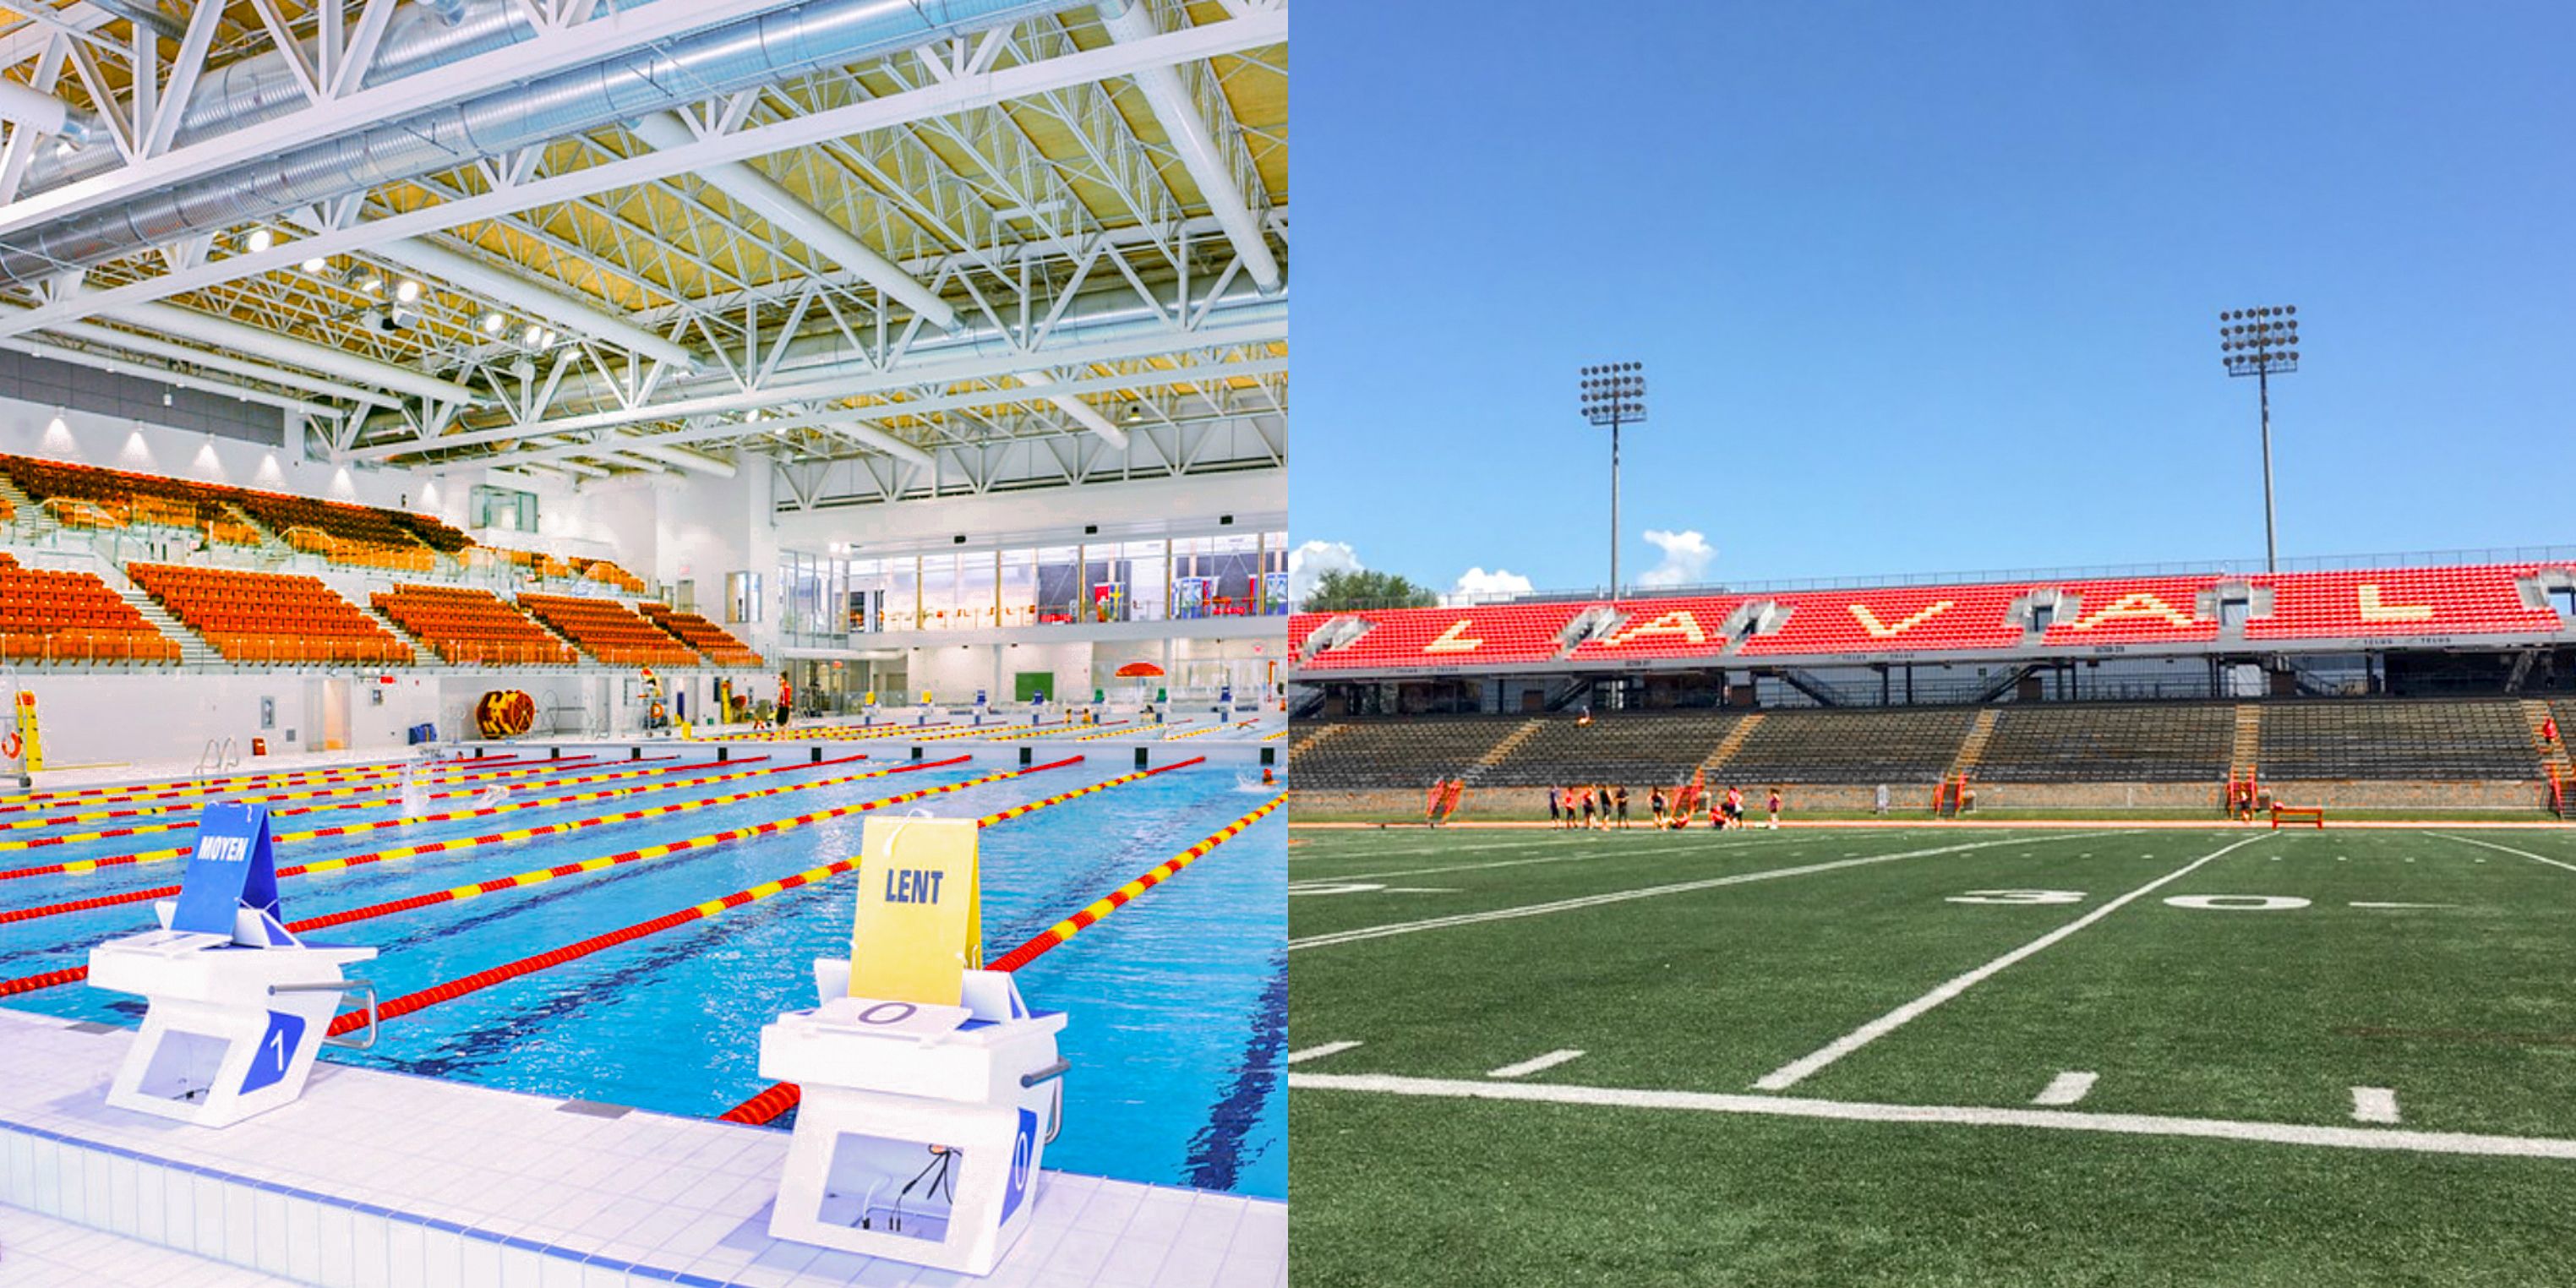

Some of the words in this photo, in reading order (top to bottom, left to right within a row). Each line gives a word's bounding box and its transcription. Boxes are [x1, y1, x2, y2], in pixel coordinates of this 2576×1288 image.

[197, 835, 249, 861] MOYEN
[885, 868, 944, 905] LENT
[270, 1029, 283, 1072] 1
[1015, 1131, 1028, 1192] 0
